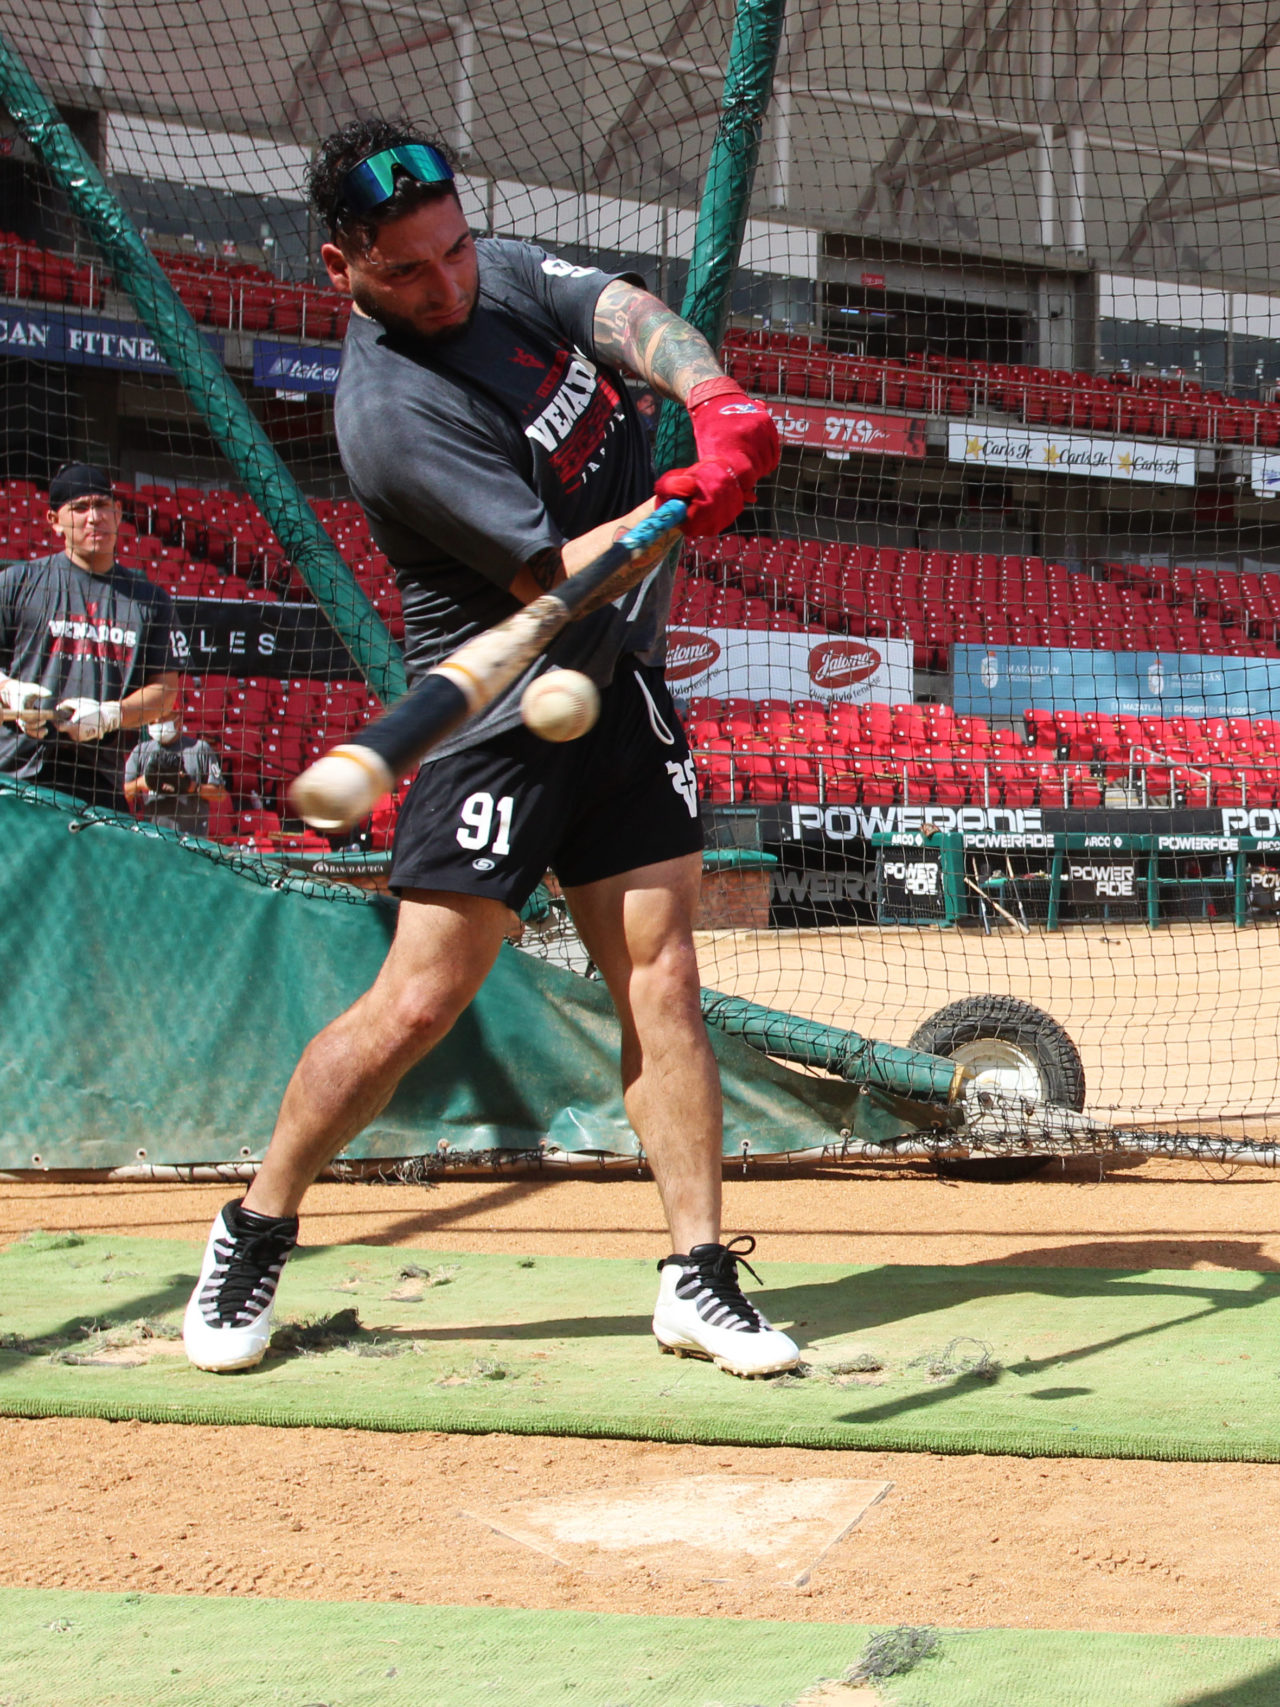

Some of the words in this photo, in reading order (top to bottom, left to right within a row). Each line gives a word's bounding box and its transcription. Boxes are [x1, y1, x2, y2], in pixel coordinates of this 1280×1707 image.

[524, 344, 597, 453] VENAD
[766, 408, 810, 433] lobo
[825, 416, 874, 443] 97.9
[48, 620, 137, 647] VENADOS
[456, 792, 514, 855] 91
[964, 833, 1055, 849] POWERADE
[1158, 836, 1239, 851] POWERADE
[883, 862, 939, 879] POWER
[1070, 865, 1135, 881] POWER
[1095, 880, 1135, 897] ADE
